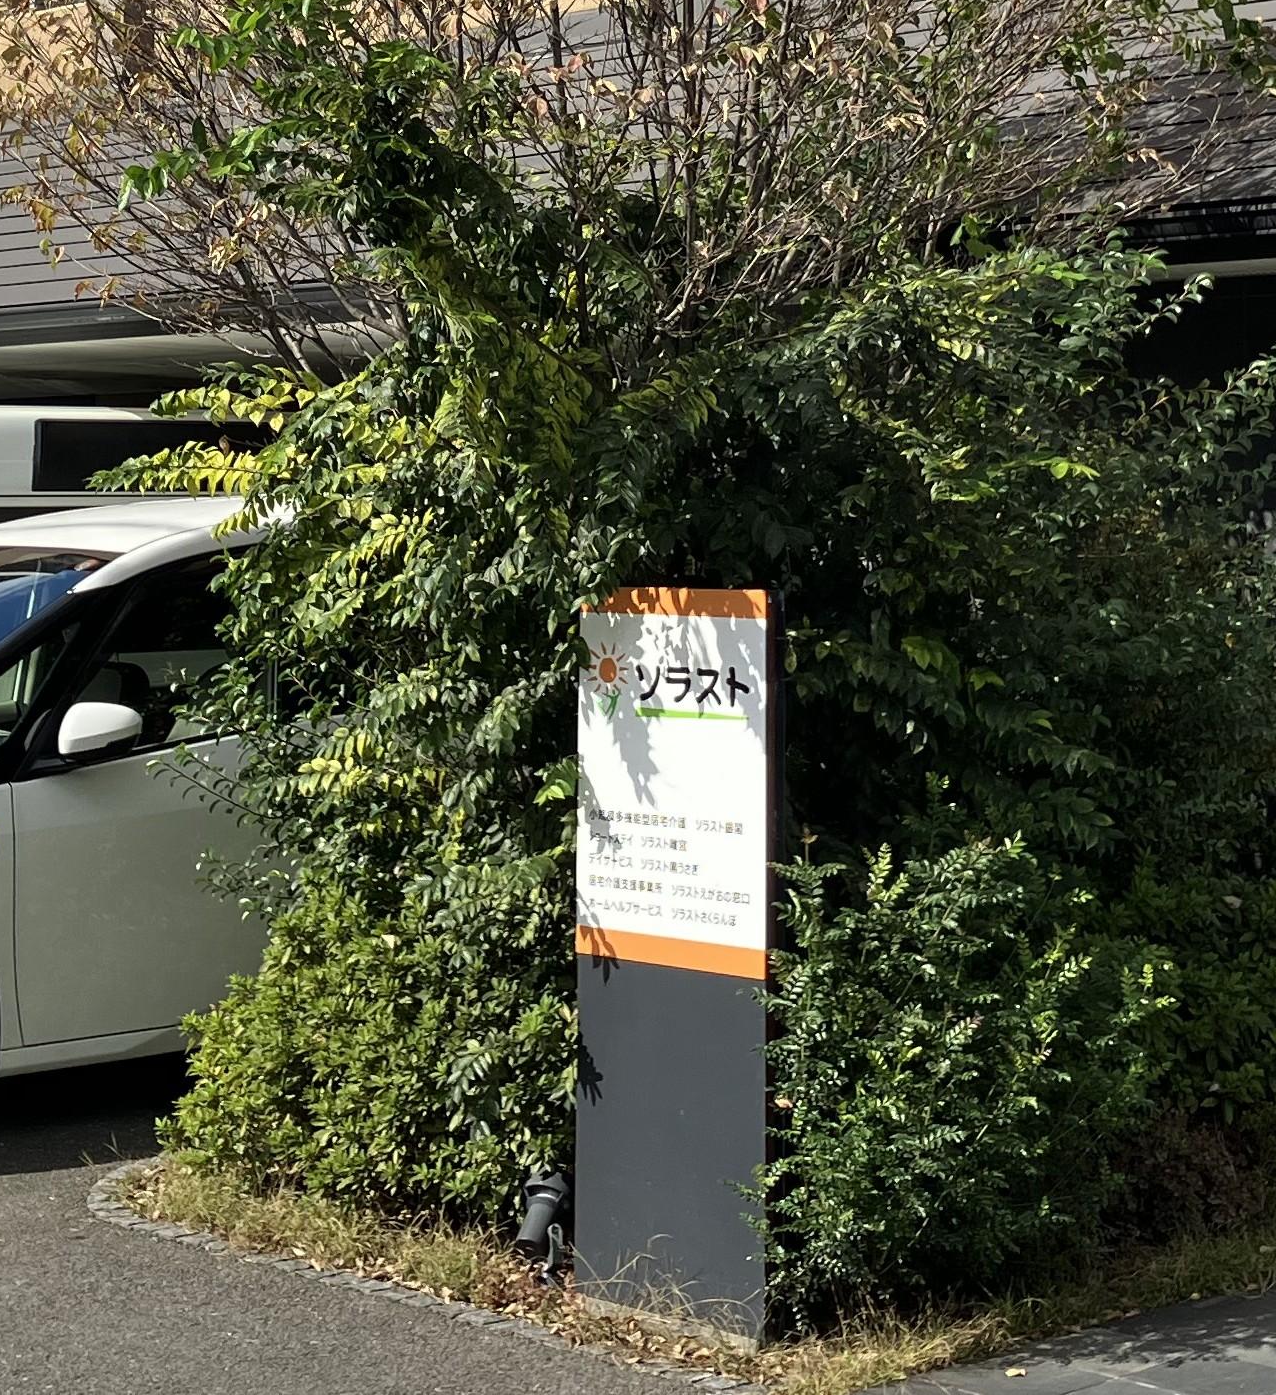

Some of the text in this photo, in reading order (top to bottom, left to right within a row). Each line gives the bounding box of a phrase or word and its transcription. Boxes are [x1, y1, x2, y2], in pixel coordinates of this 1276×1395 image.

[635, 666, 750, 708] ソラスト
[588, 853, 633, 869] デイサービス
[588, 897, 737, 927] ホームヘルプサービス ソラストさくらんぼ
